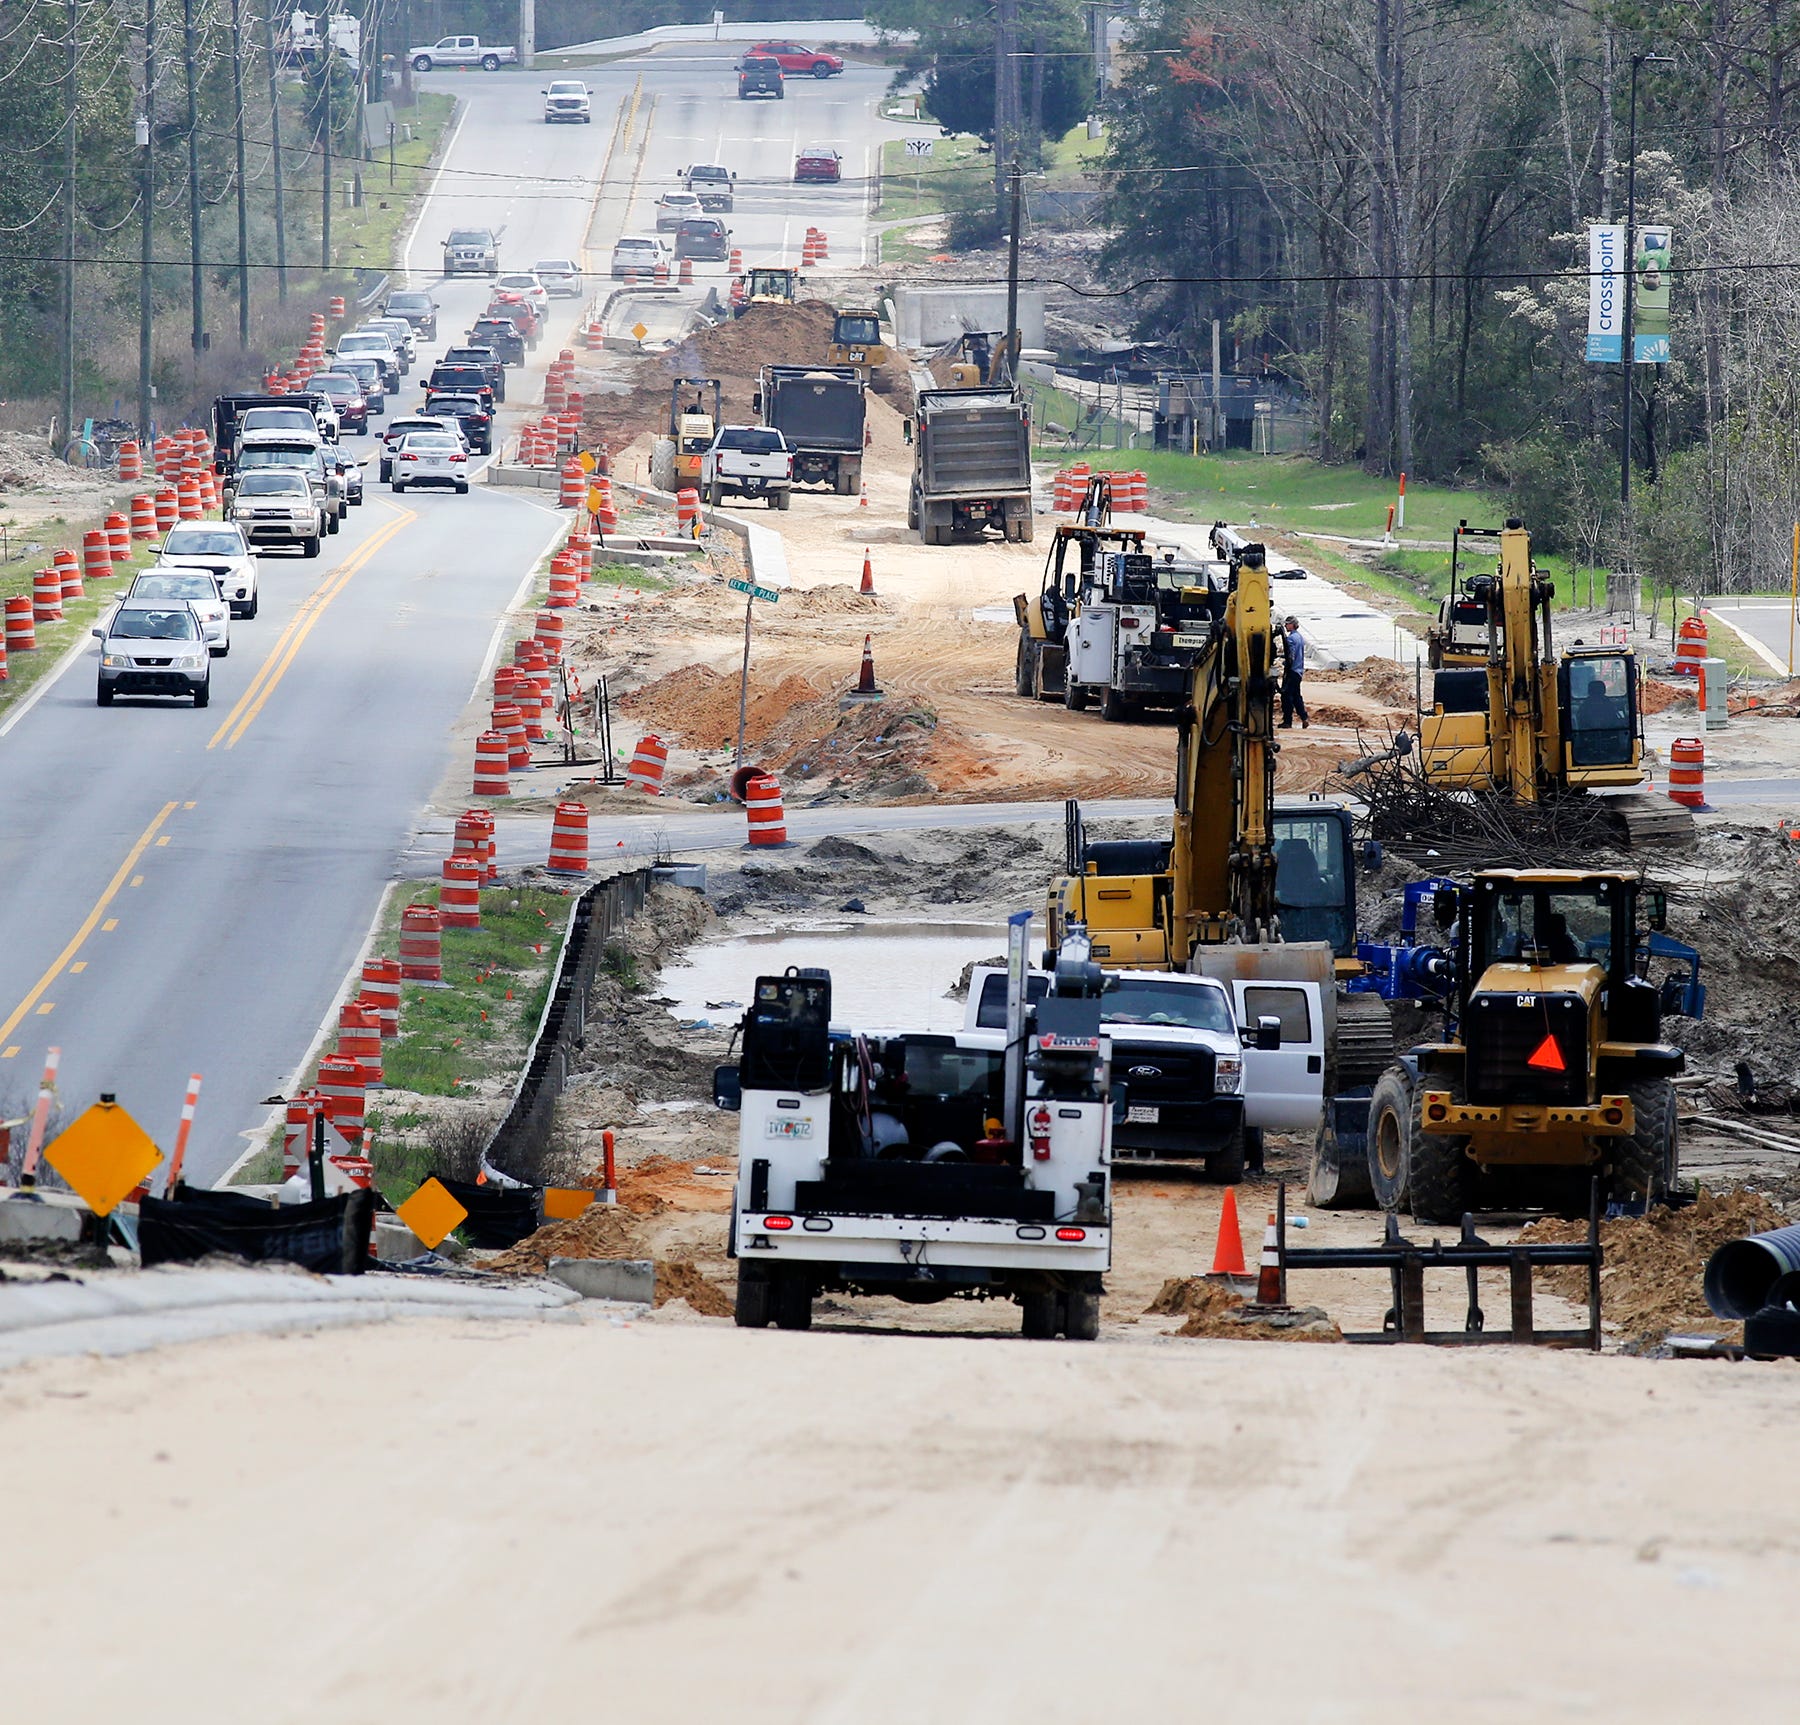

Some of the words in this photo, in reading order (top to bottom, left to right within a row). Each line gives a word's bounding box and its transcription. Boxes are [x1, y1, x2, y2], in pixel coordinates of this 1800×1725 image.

[1597, 231, 1616, 330] crosspoint
[849, 352, 864, 361] CAT
[730, 579, 741, 587] KEY
[758, 589, 777, 602] PLACE
[1517, 995, 1536, 1007] CAT
[1039, 1032, 1098, 1047] VENTURO
